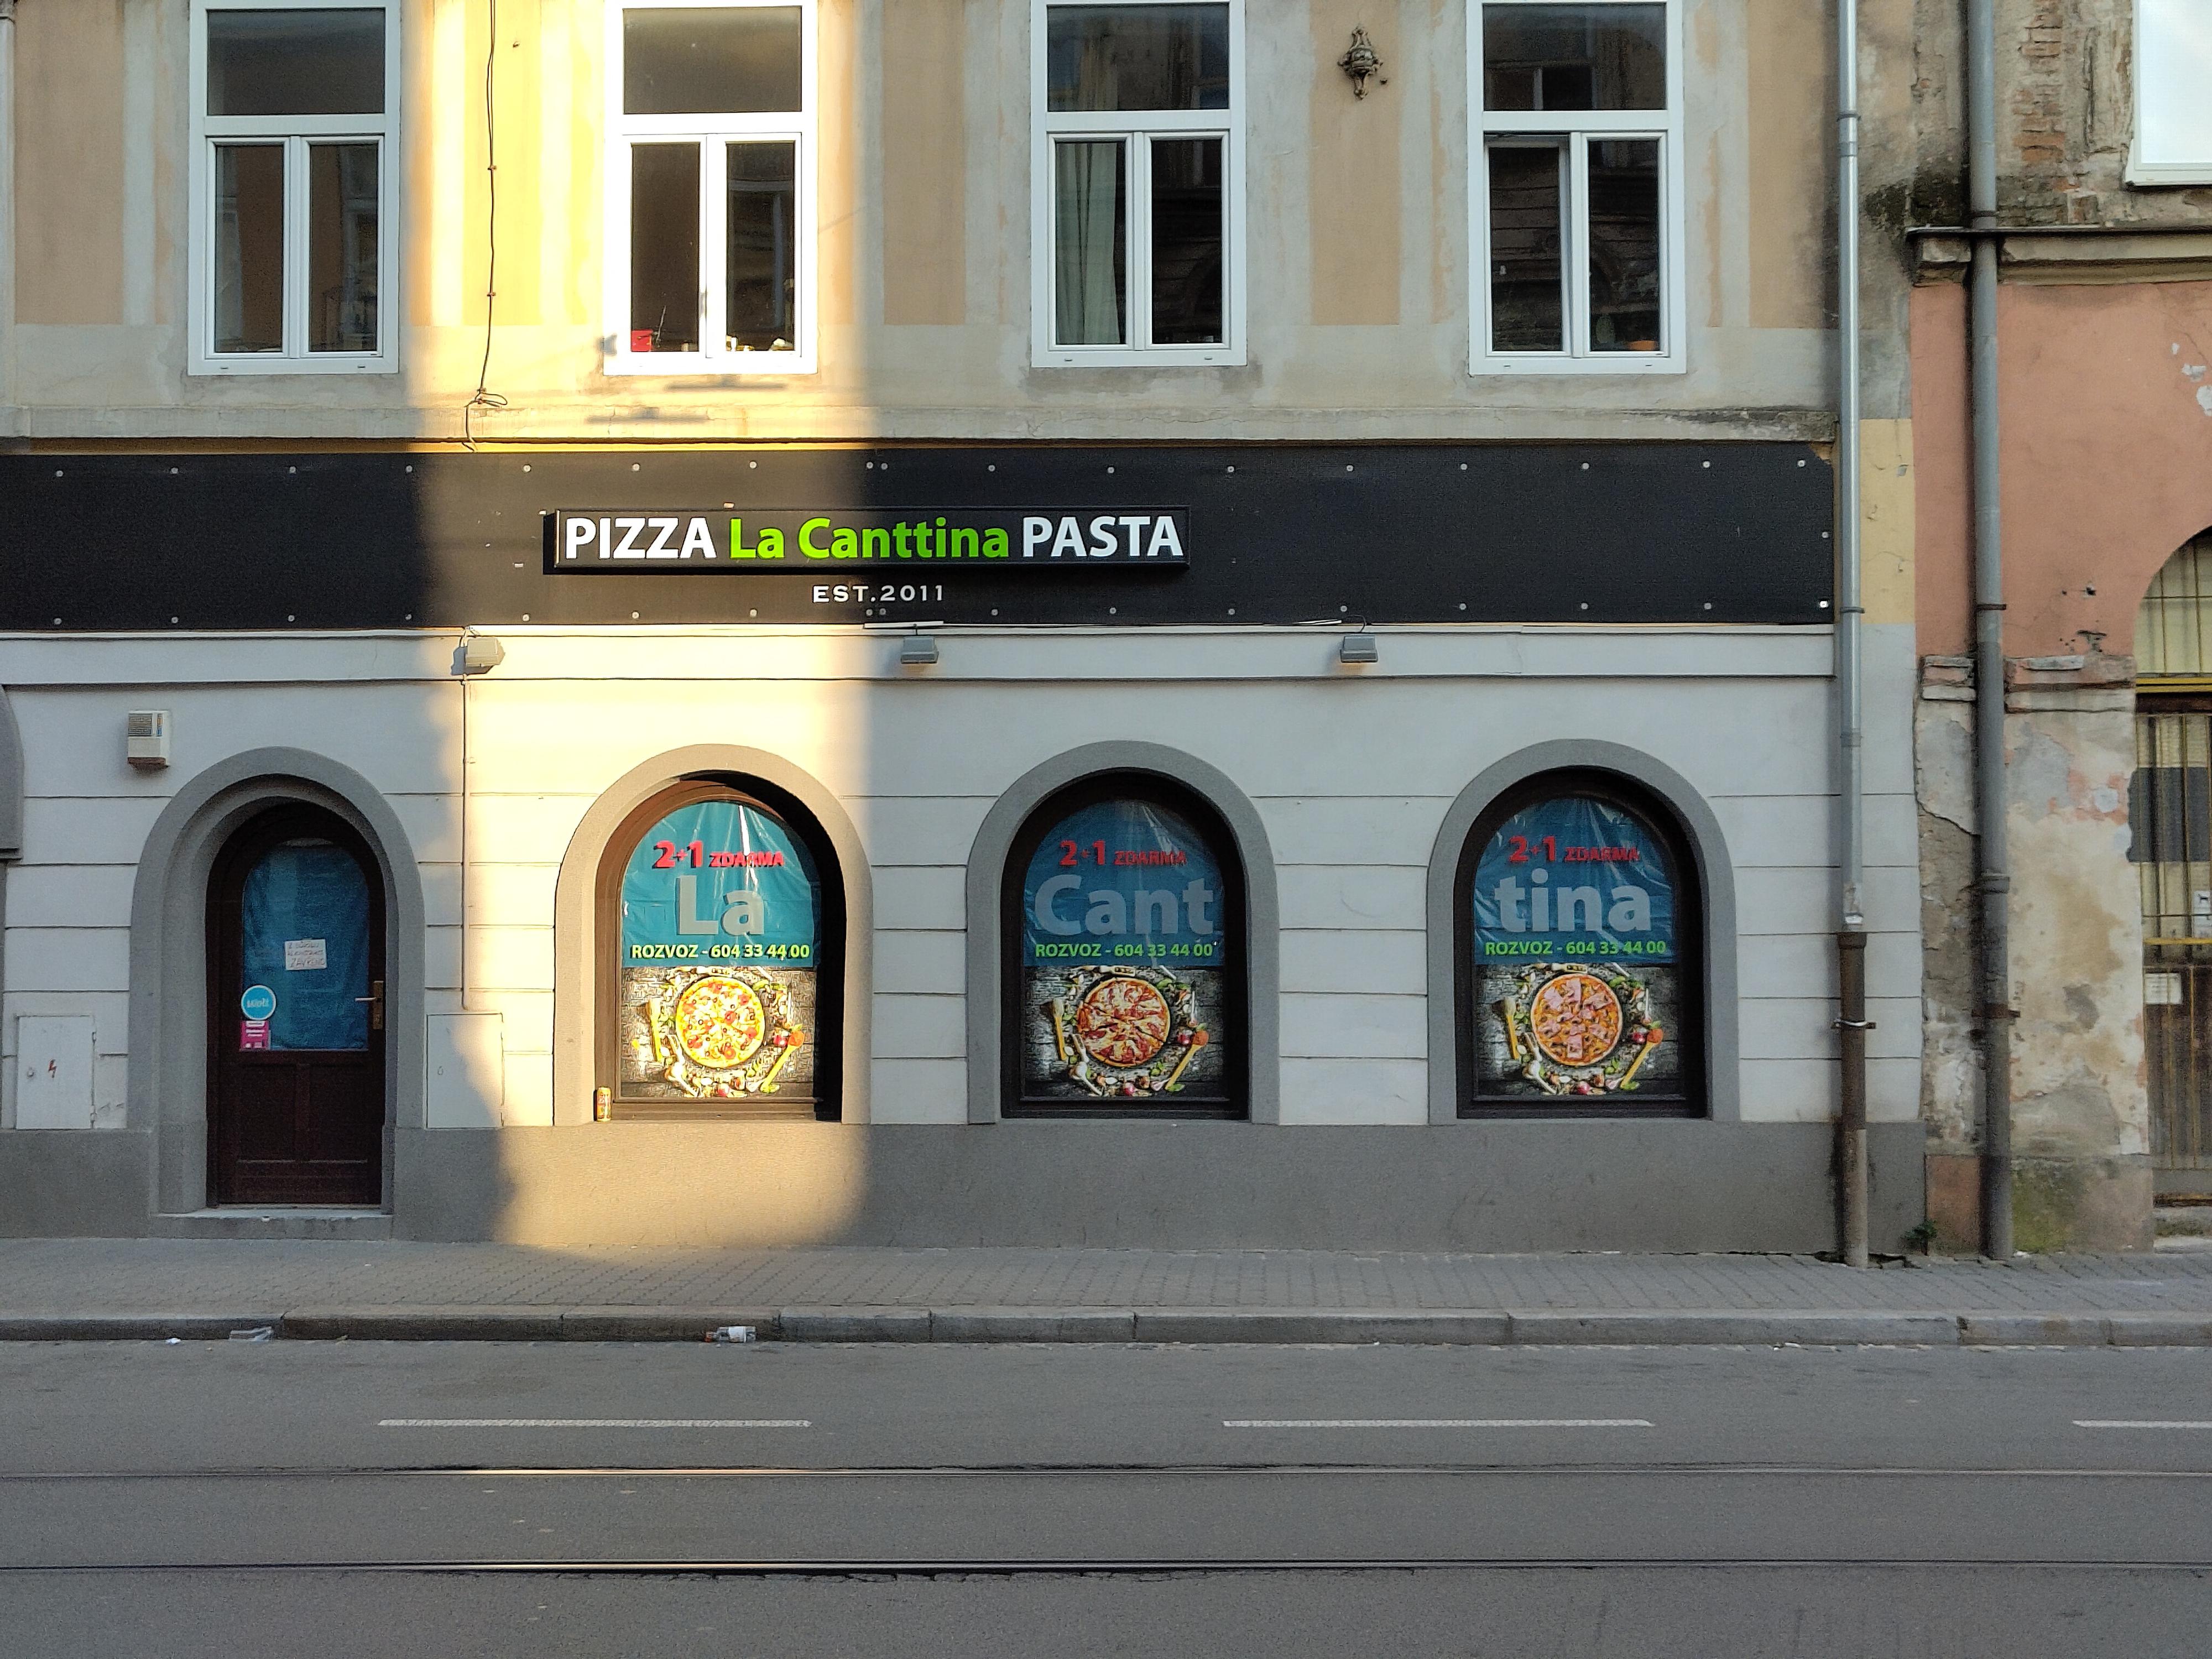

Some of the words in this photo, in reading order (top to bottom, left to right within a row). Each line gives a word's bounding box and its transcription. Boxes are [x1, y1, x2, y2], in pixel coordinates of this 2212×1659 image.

[565, 517, 717, 559] PIZZA
[729, 518, 785, 559] La
[798, 517, 1009, 559] Canttina
[1022, 516, 1184, 557] PASTA
[813, 585, 943, 603] EST.2011
[652, 840, 703, 868] 2+1
[708, 852, 785, 868] ZDARMA
[1060, 840, 1106, 866] 2+1
[1114, 851, 1187, 866] ZDARMA
[1509, 835, 1557, 862] 2+1
[1564, 847, 1640, 862] ZDARMA
[675, 875, 765, 936] La
[1035, 874, 1213, 935] Cant
[1494, 868, 1652, 932] tina
[631, 944, 699, 958] ROZVOZ
[711, 944, 741, 958] 604
[744, 944, 763, 958] 33
[767, 944, 787, 958] 44
[790, 944, 810, 958] 00
[1036, 943, 1102, 957] ROZVOZ
[1114, 943, 1144, 957] 604
[1147, 943, 1166, 957] 33
[1170, 943, 1190, 957] 44
[1193, 943, 1213, 957] 00
[1485, 941, 1553, 954] ROZVOZ
[1566, 941, 1596, 954] 604
[1600, 941, 1619, 954] 33
[1623, 941, 1642, 954] 44
[1646, 941, 1666, 954] 00
